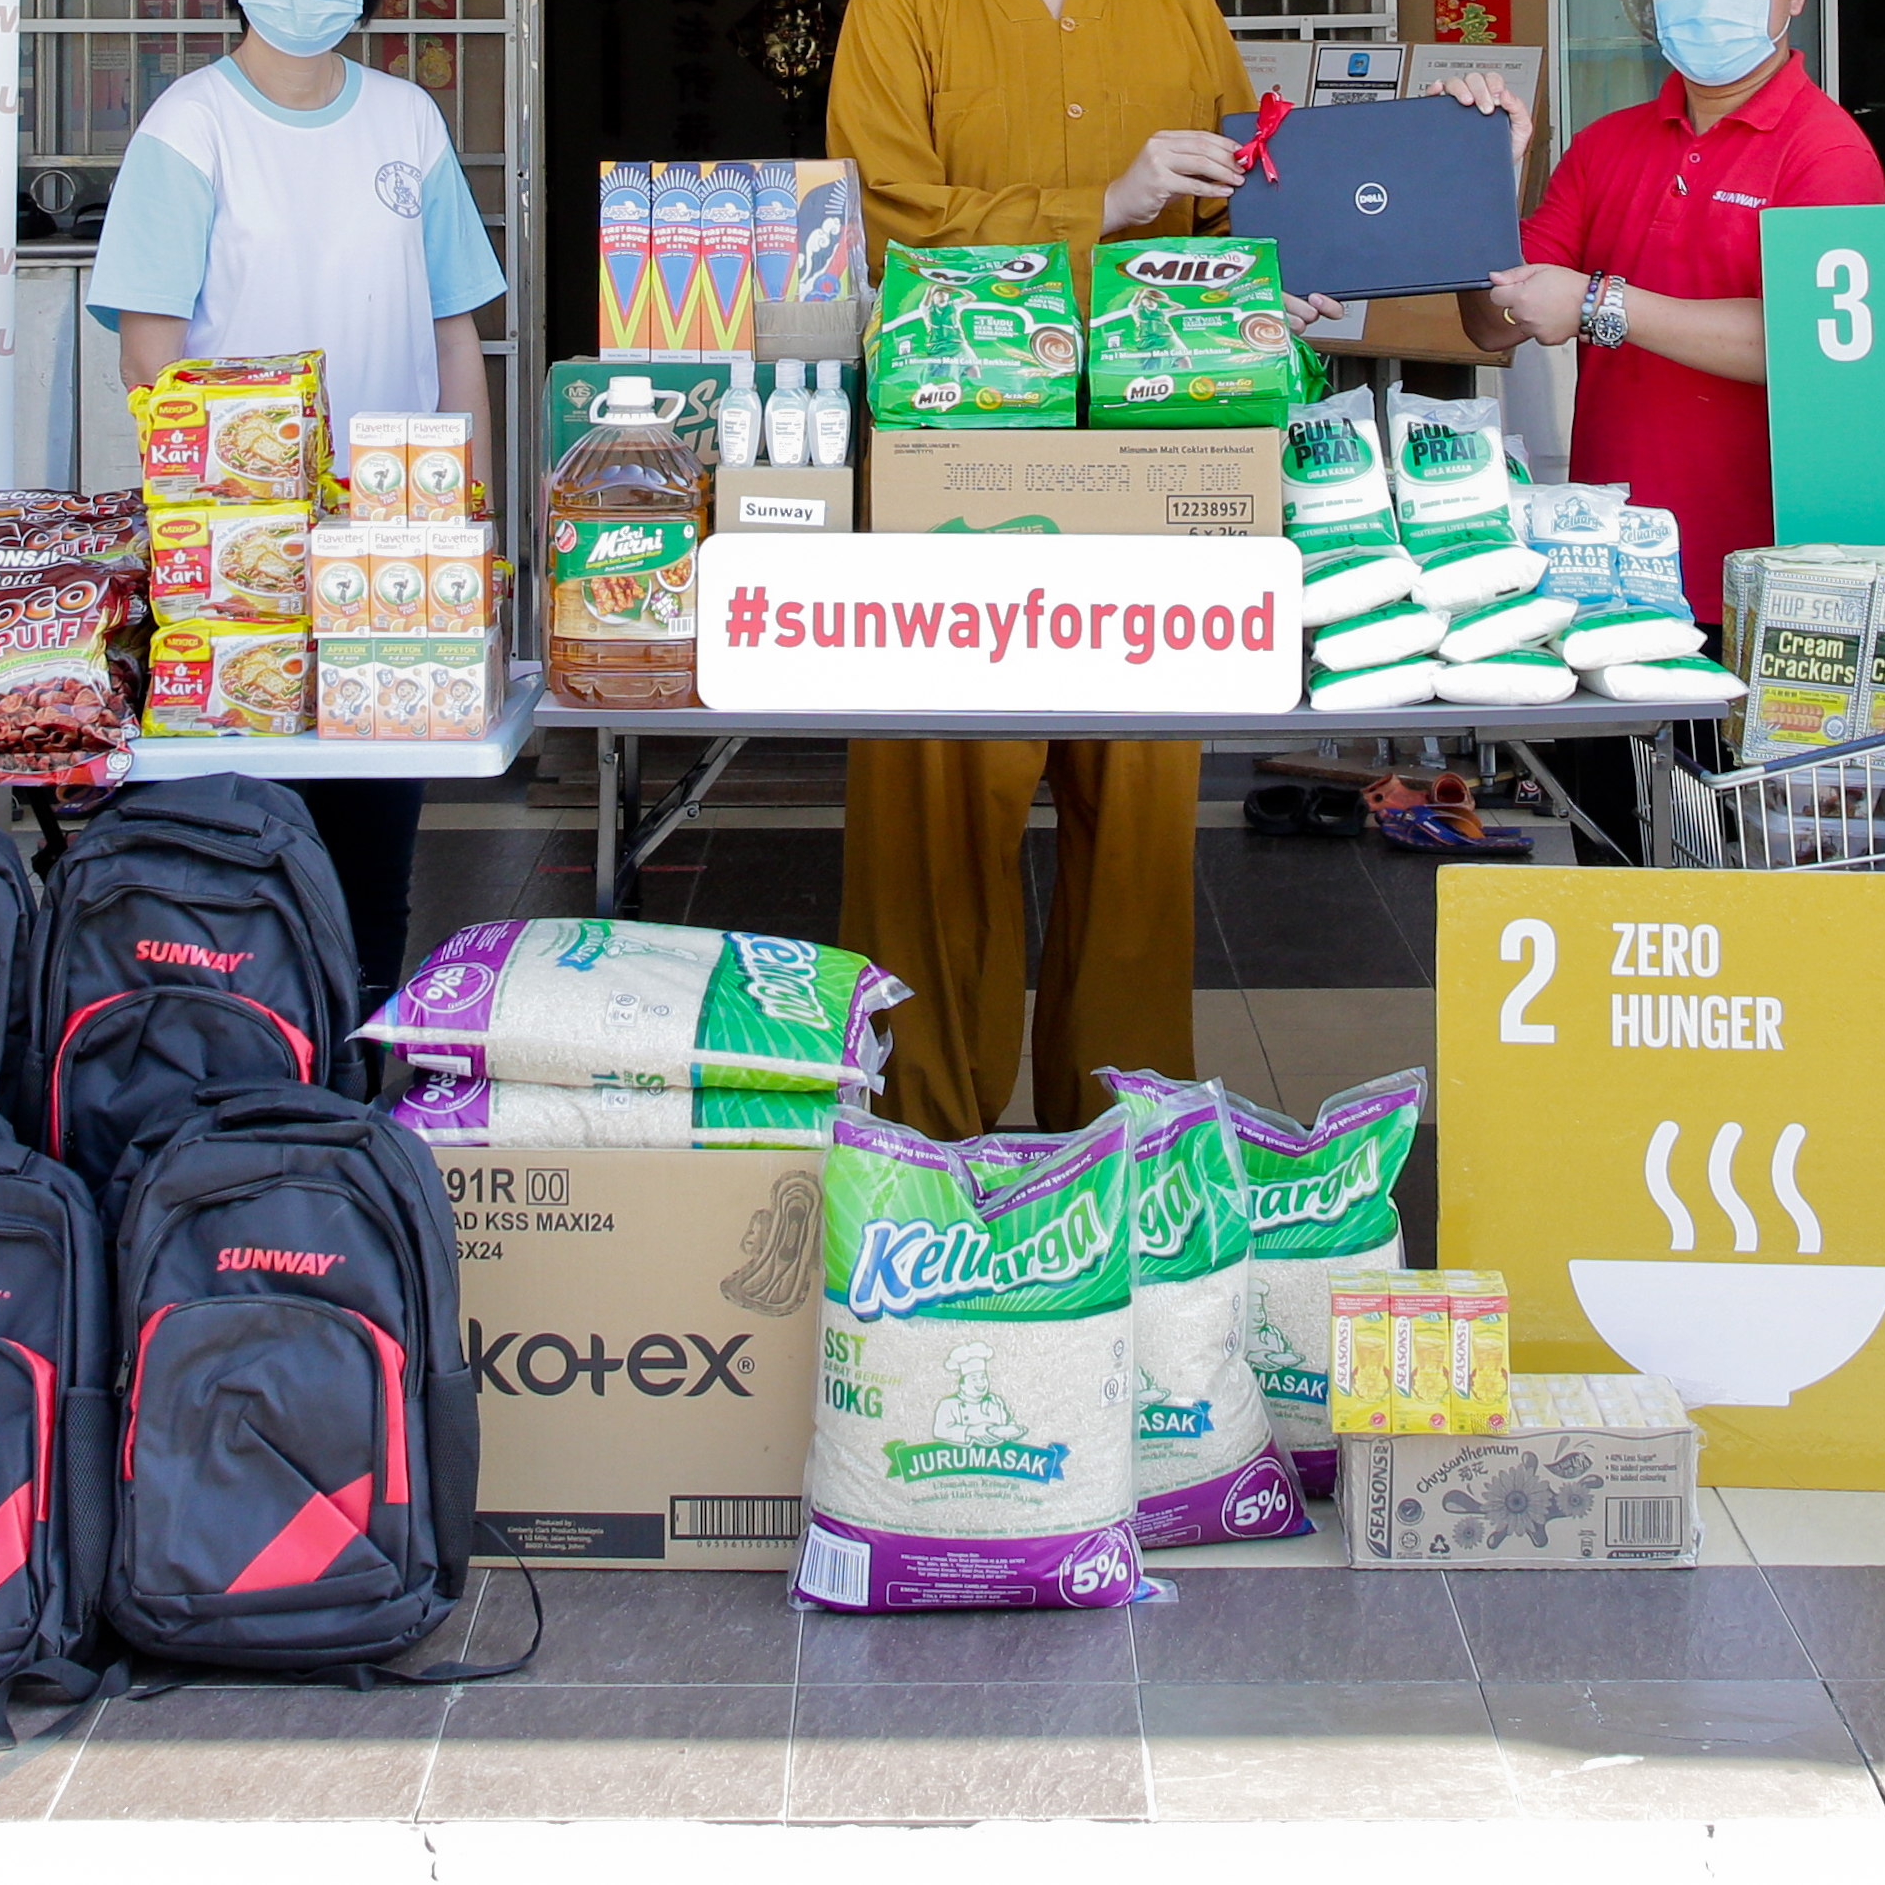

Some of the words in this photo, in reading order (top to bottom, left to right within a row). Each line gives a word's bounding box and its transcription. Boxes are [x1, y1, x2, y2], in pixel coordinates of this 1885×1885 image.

[1712, 191, 1762, 209] SUNWAY
[1816, 248, 1873, 363] 3
[918, 390, 957, 405] MILO
[1130, 383, 1169, 400] MILO
[1288, 417, 1360, 448] GULA
[151, 444, 200, 464] Kari
[1119, 446, 1157, 454] Minuman
[1159, 446, 1180, 454] Malt
[1182, 446, 1209, 454] Coklat
[1210, 446, 1255, 455] Berkhasiat
[1295, 440, 1360, 470] PRAI
[1412, 440, 1478, 467] PRAI
[1306, 469, 1329, 480] GULA
[1329, 467, 1356, 478] KASAR
[1423, 468, 1446, 477] GULA
[1446, 464, 1473, 476] KASAR
[745, 502, 814, 521] Sunway
[1172, 502, 1248, 518] 12238957
[1547, 546, 1609, 557] GARAM
[1550, 556, 1609, 568] HALUS
[155, 565, 203, 585] Kari
[1771, 594, 1805, 617] HUP
[725, 586, 1275, 665] #sunwayforgood
[1778, 630, 1844, 660] Cream
[1760, 653, 1856, 685] Crackers
[154, 675, 203, 695] Kari
[135, 938, 246, 973] SUNWAY
[1610, 922, 1721, 978] ZERO
[1498, 918, 1557, 1044] 2
[1610, 993, 1785, 1051] HUNGER
[437, 1168, 516, 1203] 91R
[531, 1172, 564, 1202] 00
[485, 1212, 529, 1231] KSS
[536, 1212, 615, 1232] MAXI24
[217, 1246, 338, 1277] SUNWAY
[849, 1189, 1111, 1319] Keluarga
[468, 1317, 755, 1397] kotex
[824, 1328, 867, 1368] SST
[1337, 1328, 1349, 1387] SEASONS
[1397, 1328, 1410, 1388] SEASONS
[1455, 1329, 1468, 1388] SEASONS
[854, 1369, 902, 1386] BERSIH
[1257, 1370, 1324, 1401] MASAK
[823, 1377, 884, 1419] 10KG
[907, 1446, 1049, 1477] JURUMASAK
[1416, 1444, 1520, 1495] Chrysanthemum
[1234, 1480, 1287, 1528] 5%
[1370, 1453, 1388, 1541] SEASONS
[1071, 1546, 1128, 1595] 5%
